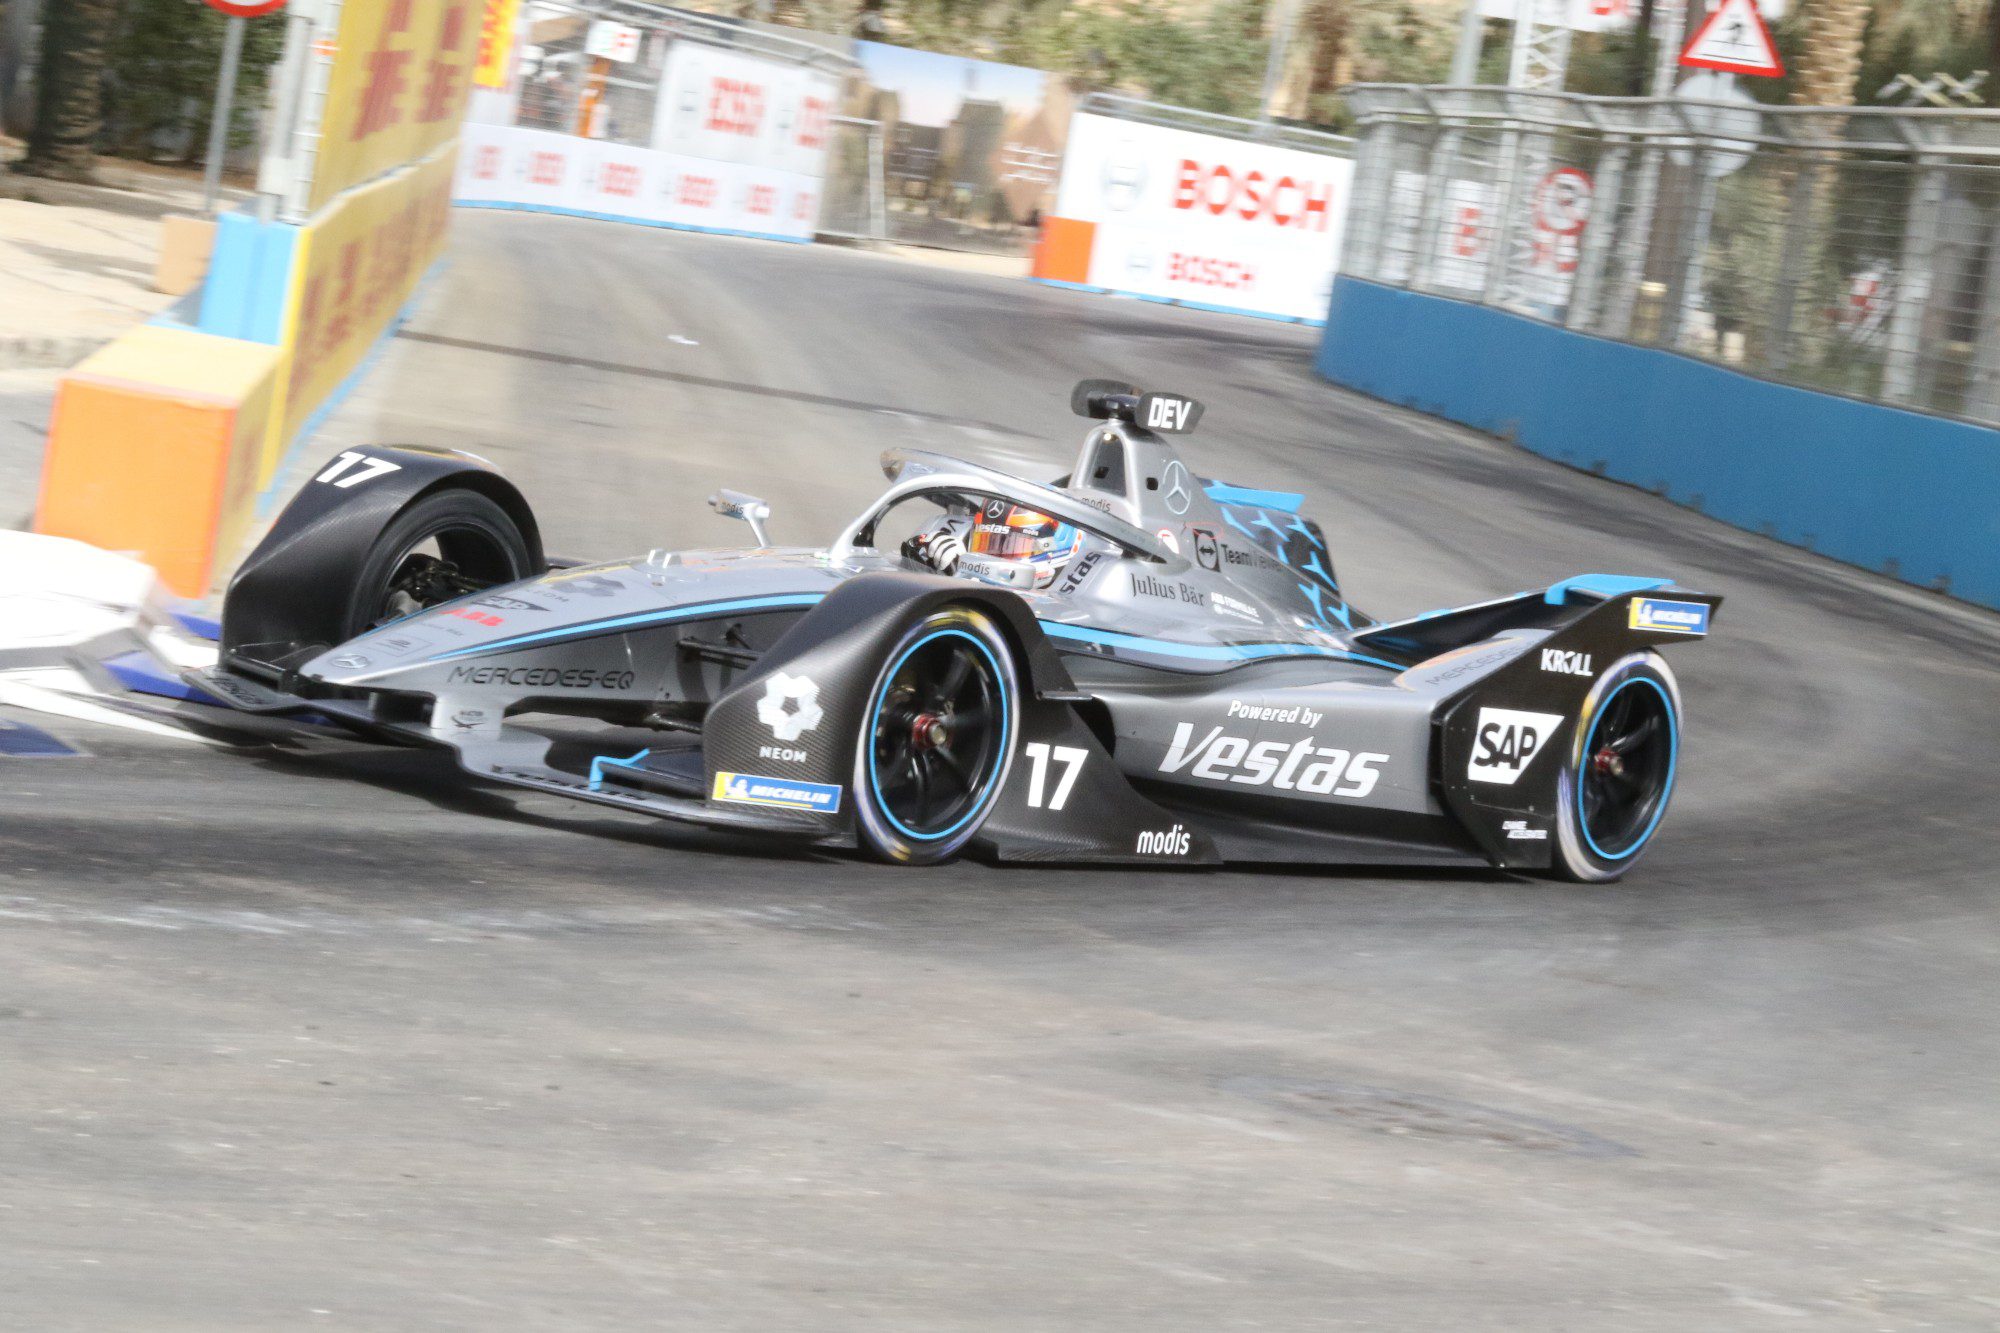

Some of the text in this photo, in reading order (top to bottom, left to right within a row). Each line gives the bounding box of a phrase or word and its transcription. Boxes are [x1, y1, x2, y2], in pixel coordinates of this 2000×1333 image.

[1171, 159, 1334, 232] BOSCH
[1166, 252, 1257, 289] BOSCH
[1148, 397, 1192, 431] DEV
[316, 451, 402, 488] 17
[959, 560, 991, 576] modis
[1130, 573, 1205, 607] Julius Bär
[448, 666, 635, 690] MERCEDES-EQ
[1227, 700, 1323, 728] Powered by
[759, 746, 807, 762] NEOM
[1157, 721, 1390, 798] Vestas
[1473, 722, 1538, 770] SAP
[1026, 743, 1088, 810] 17
[749, 785, 832, 803] MICHELIN
[1136, 824, 1191, 855] modis
